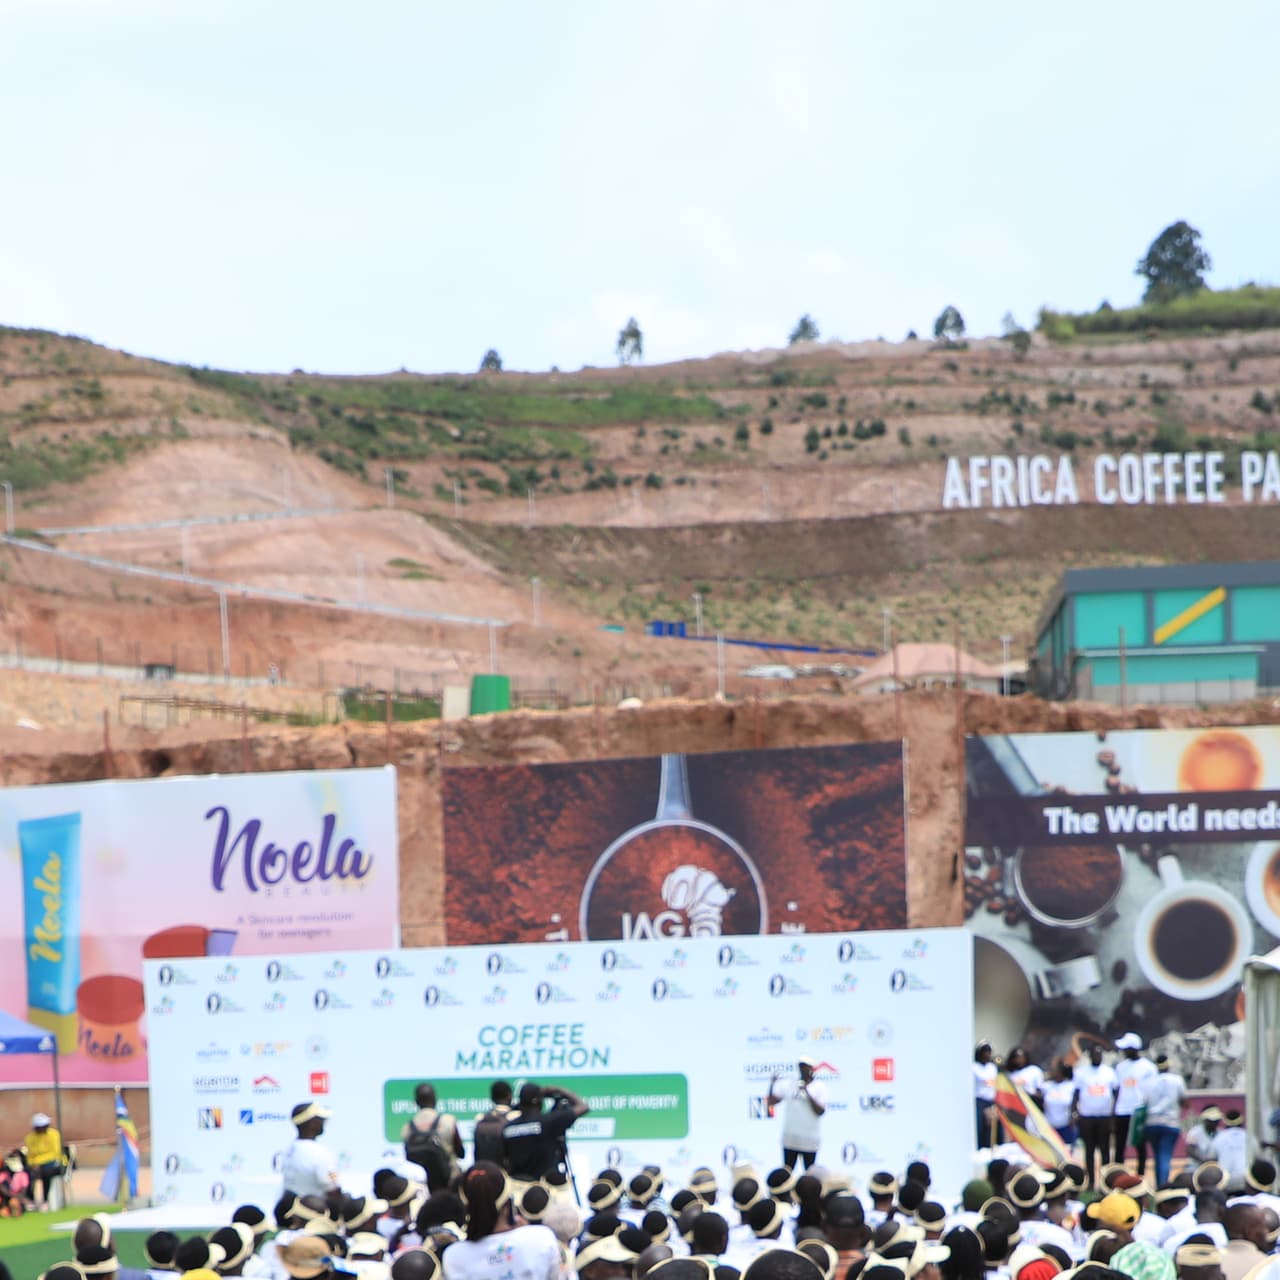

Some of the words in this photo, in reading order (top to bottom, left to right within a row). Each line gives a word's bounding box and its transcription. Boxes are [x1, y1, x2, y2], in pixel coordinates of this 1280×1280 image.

[941, 455, 1078, 508] AFRICA
[1093, 451, 1225, 504] COFFEE
[1043, 807, 1099, 834] The
[1106, 804, 1198, 832] World
[205, 805, 373, 893] Noela
[30, 851, 62, 963] Noela
[478, 1024, 585, 1048] COFFEE
[455, 1047, 610, 1072] MARATHON
